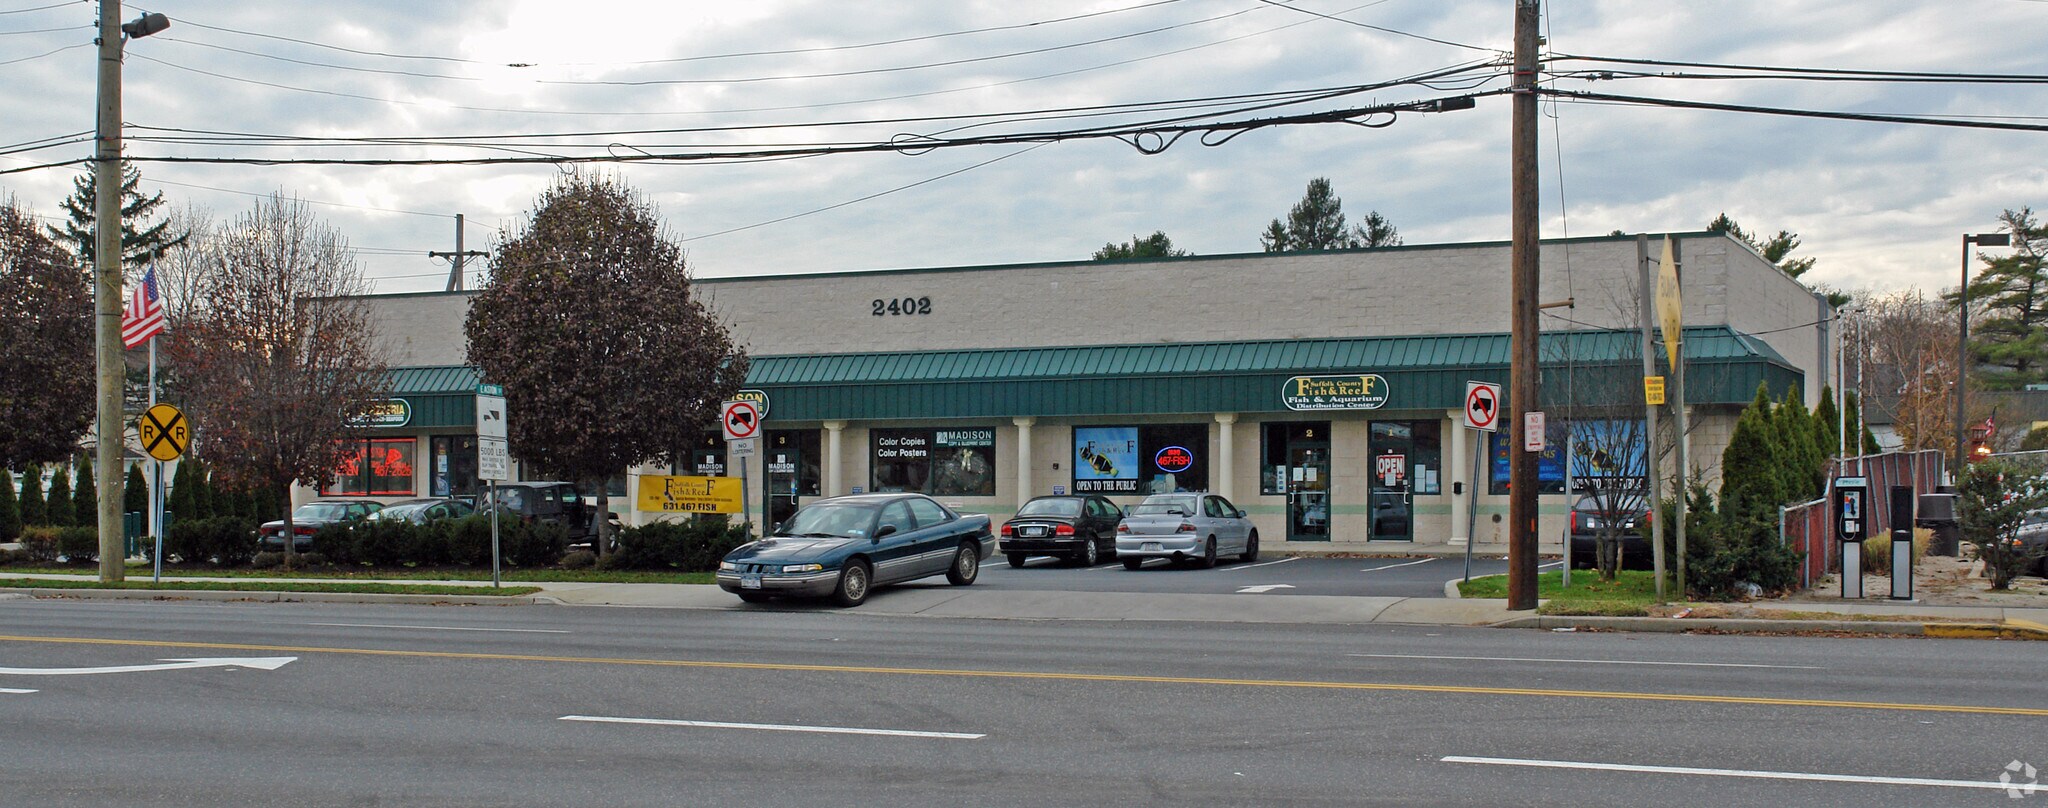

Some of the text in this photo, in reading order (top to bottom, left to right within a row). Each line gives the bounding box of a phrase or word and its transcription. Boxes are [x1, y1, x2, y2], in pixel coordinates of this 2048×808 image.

[872, 297, 931, 316] 2402
[1329, 395, 1383, 403] Aquarium
[144, 425, 153, 439] R
[176, 427, 185, 440] R
[948, 430, 992, 440] MADISON
[1306, 429, 1313, 437] 2
[1388, 429, 1394, 437] 1
[779, 436, 785, 445] 3
[879, 437, 926, 447] Color Copies
[480, 447, 494, 456] 5000
[878, 448, 927, 457] Color Posters
[1158, 456, 1190, 465] 467-FISH
[1378, 458, 1403, 474] OPEN
[1076, 480, 1137, 490] OPEN TO THE PUBLIC
[663, 502, 717, 511] 631.467.FISH
